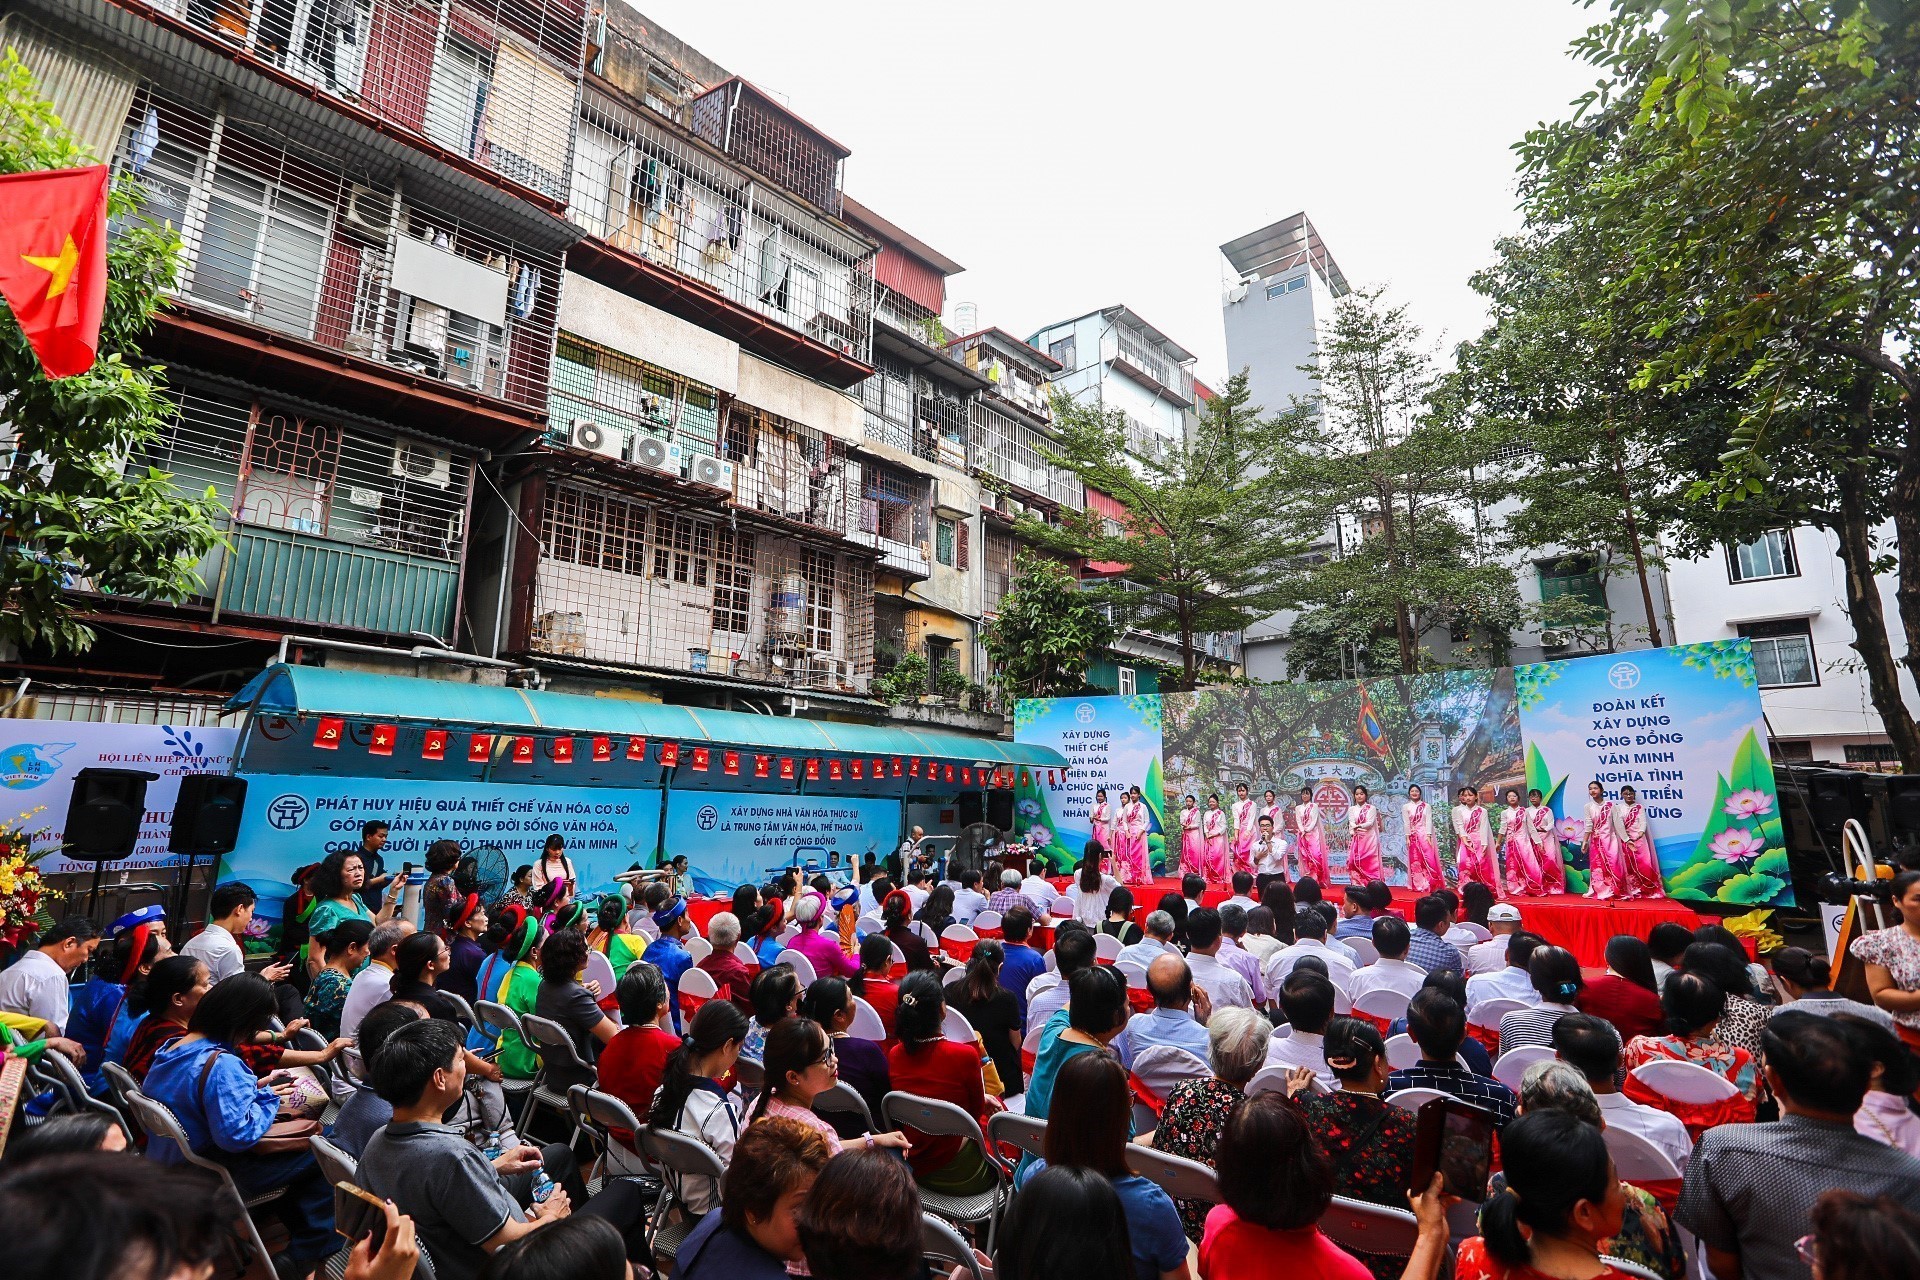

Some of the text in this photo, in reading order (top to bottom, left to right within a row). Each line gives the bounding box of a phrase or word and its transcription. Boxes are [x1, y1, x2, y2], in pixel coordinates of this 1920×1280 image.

[1592, 693, 1666, 712] ĐOÀN KẾT
[1592, 715, 1670, 730] XÂY DỰNG
[1062, 730, 1110, 740] XÂY DỰNG
[1586, 730, 1684, 750] CỘNG ĐỒNG
[1064, 741, 1110, 752] THIẾT CHẾ
[124, 752, 150, 762] LIÊN
[1088, 756, 1108, 764] HÓA
[1598, 752, 1674, 765] VĂN MINH
[1067, 769, 1107, 780] HIỆN ĐẠI
[1596, 768, 1684, 782] NGHĨA TÌNH
[1066, 782, 1094, 790] CHỨC
[1096, 782, 1124, 790] NĂNG
[1641, 784, 1684, 800] TRIỂN
[316, 796, 630, 816] PHÁT HUY HIỆU QUẢ THIẾT CHẾ VĂN HÓA CƠ SỞ
[1067, 796, 1092, 806] PHỤC
[731, 806, 859, 820] XÂY DỰNG NHÀ VĂN HÓA THỰC SỰ
[1063, 808, 1090, 818] NHÂN
[1645, 806, 1682, 818] ỮNG
[388, 814, 414, 832] HẦN
[418, 818, 448, 832] XÂY
[452, 818, 492, 834] DỰNG
[496, 818, 520, 832] ĐỜI
[524, 816, 559, 832] SỐNG
[562, 819, 588, 832] VĂN
[590, 820, 618, 834] HÓA,
[720, 820, 864, 832] LÀ TRUNG TÂM VĂN HÓA, THỂ THAO VÀ
[380, 837, 420, 852] GƯỜI
[479, 840, 522, 850] THANH
[526, 840, 546, 852] LỊC
[588, 840, 618, 850] MINH
[774, 834, 788, 846] KẾT
